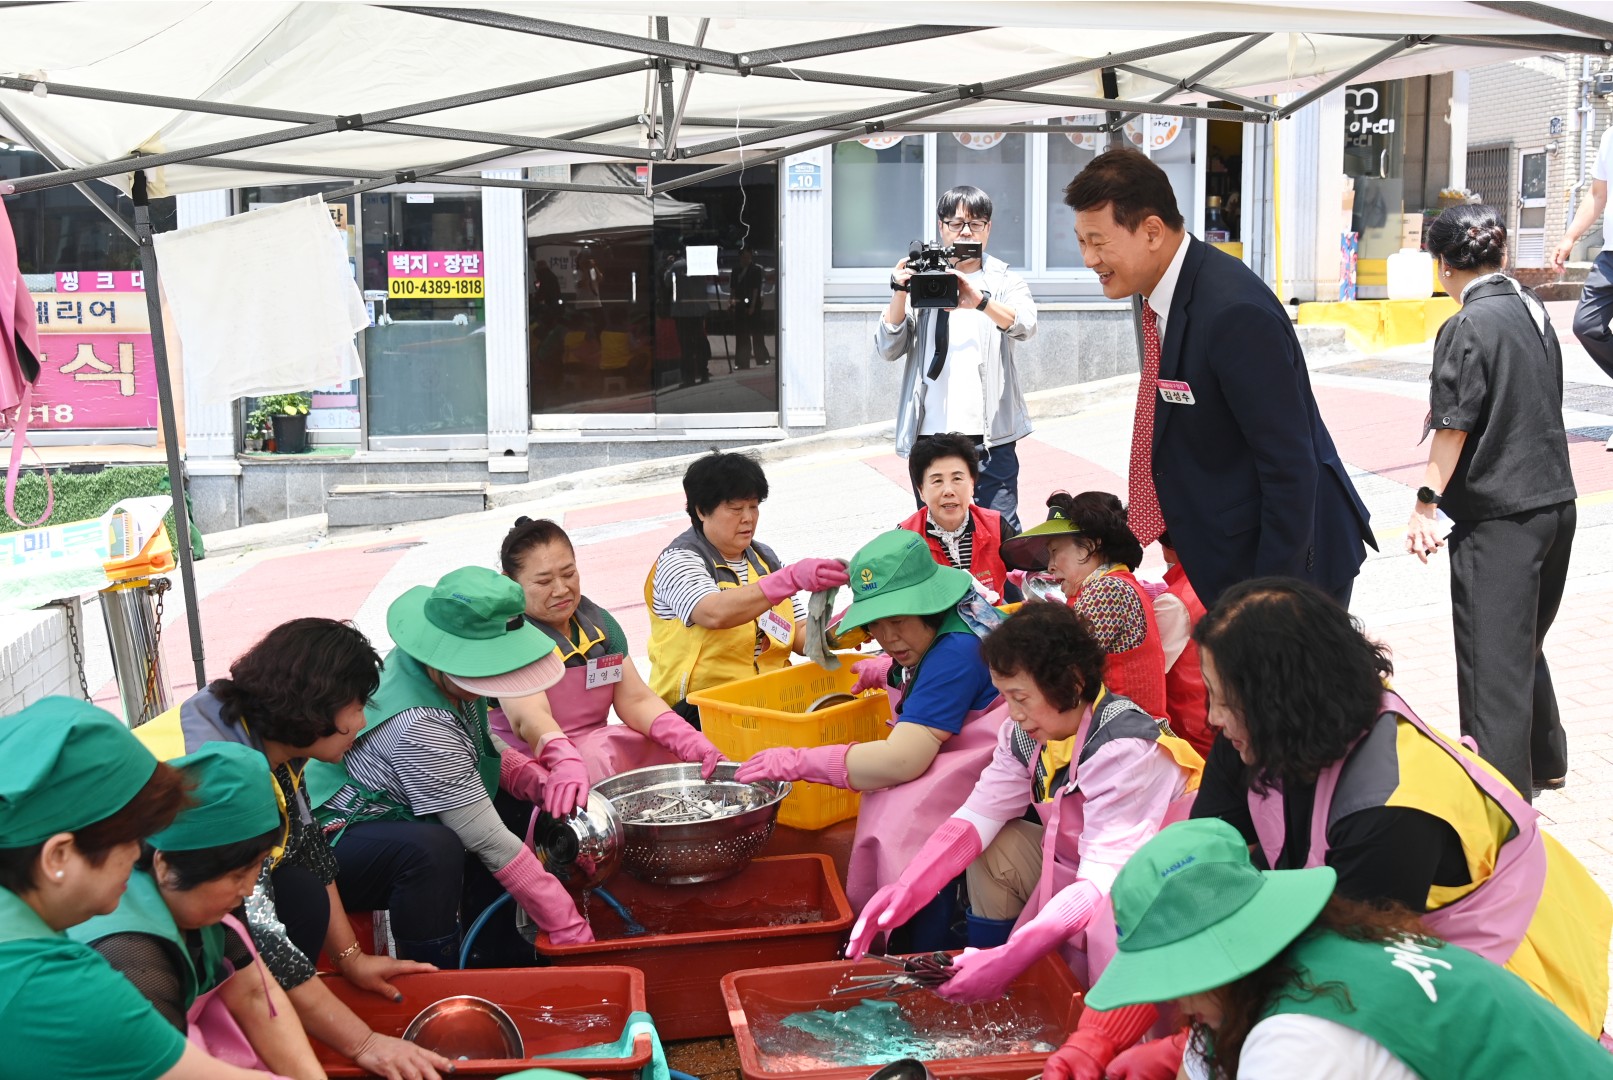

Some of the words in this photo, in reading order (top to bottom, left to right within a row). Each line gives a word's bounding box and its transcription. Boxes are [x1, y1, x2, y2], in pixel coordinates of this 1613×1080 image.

[797, 175, 813, 188] 10
[392, 254, 428, 274] 벽지
[444, 254, 479, 274] 장판
[392, 280, 482, 294] 010-4389-1818
[40, 342, 136, 397] 식
[1163, 390, 1190, 402] 김성수
